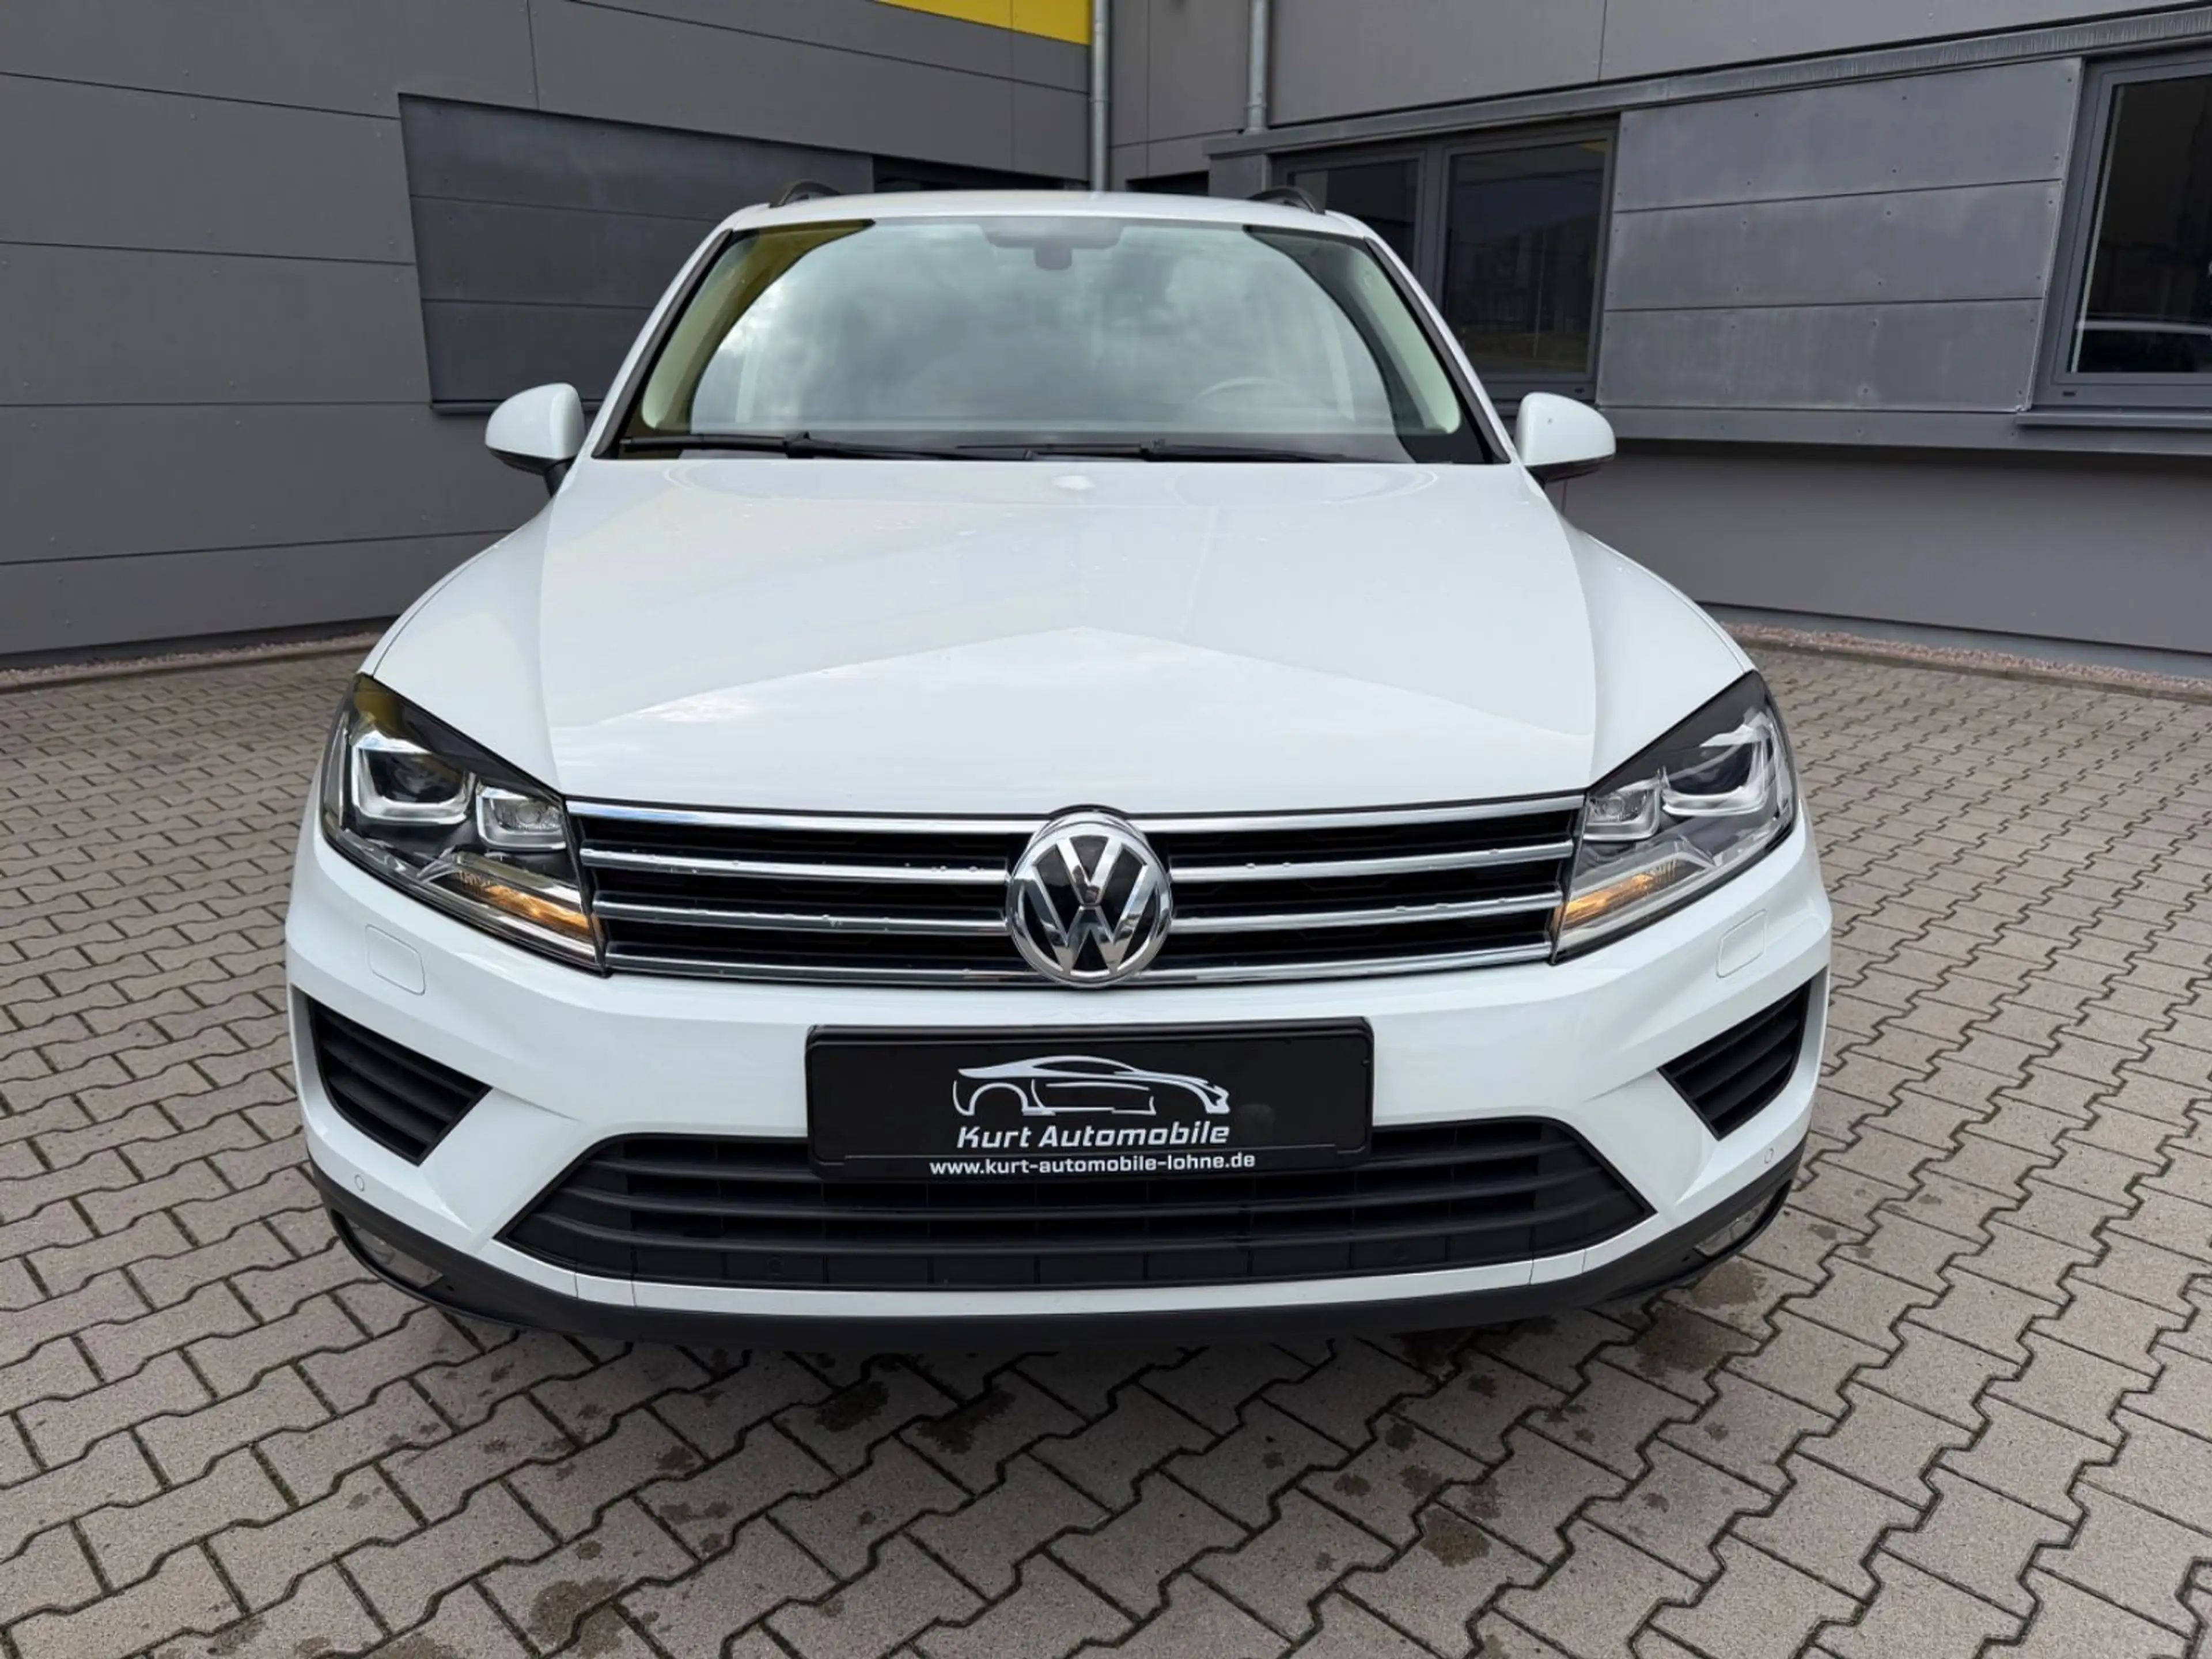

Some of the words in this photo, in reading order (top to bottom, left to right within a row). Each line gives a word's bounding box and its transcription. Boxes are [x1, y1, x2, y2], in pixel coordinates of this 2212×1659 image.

[1014, 825, 1167, 982] VW
[957, 1126, 1032, 1148] Kurt
[1038, 1120, 1230, 1147] Automobile
[929, 1152, 1255, 1175] www.kurt-automobile-lohne.de
